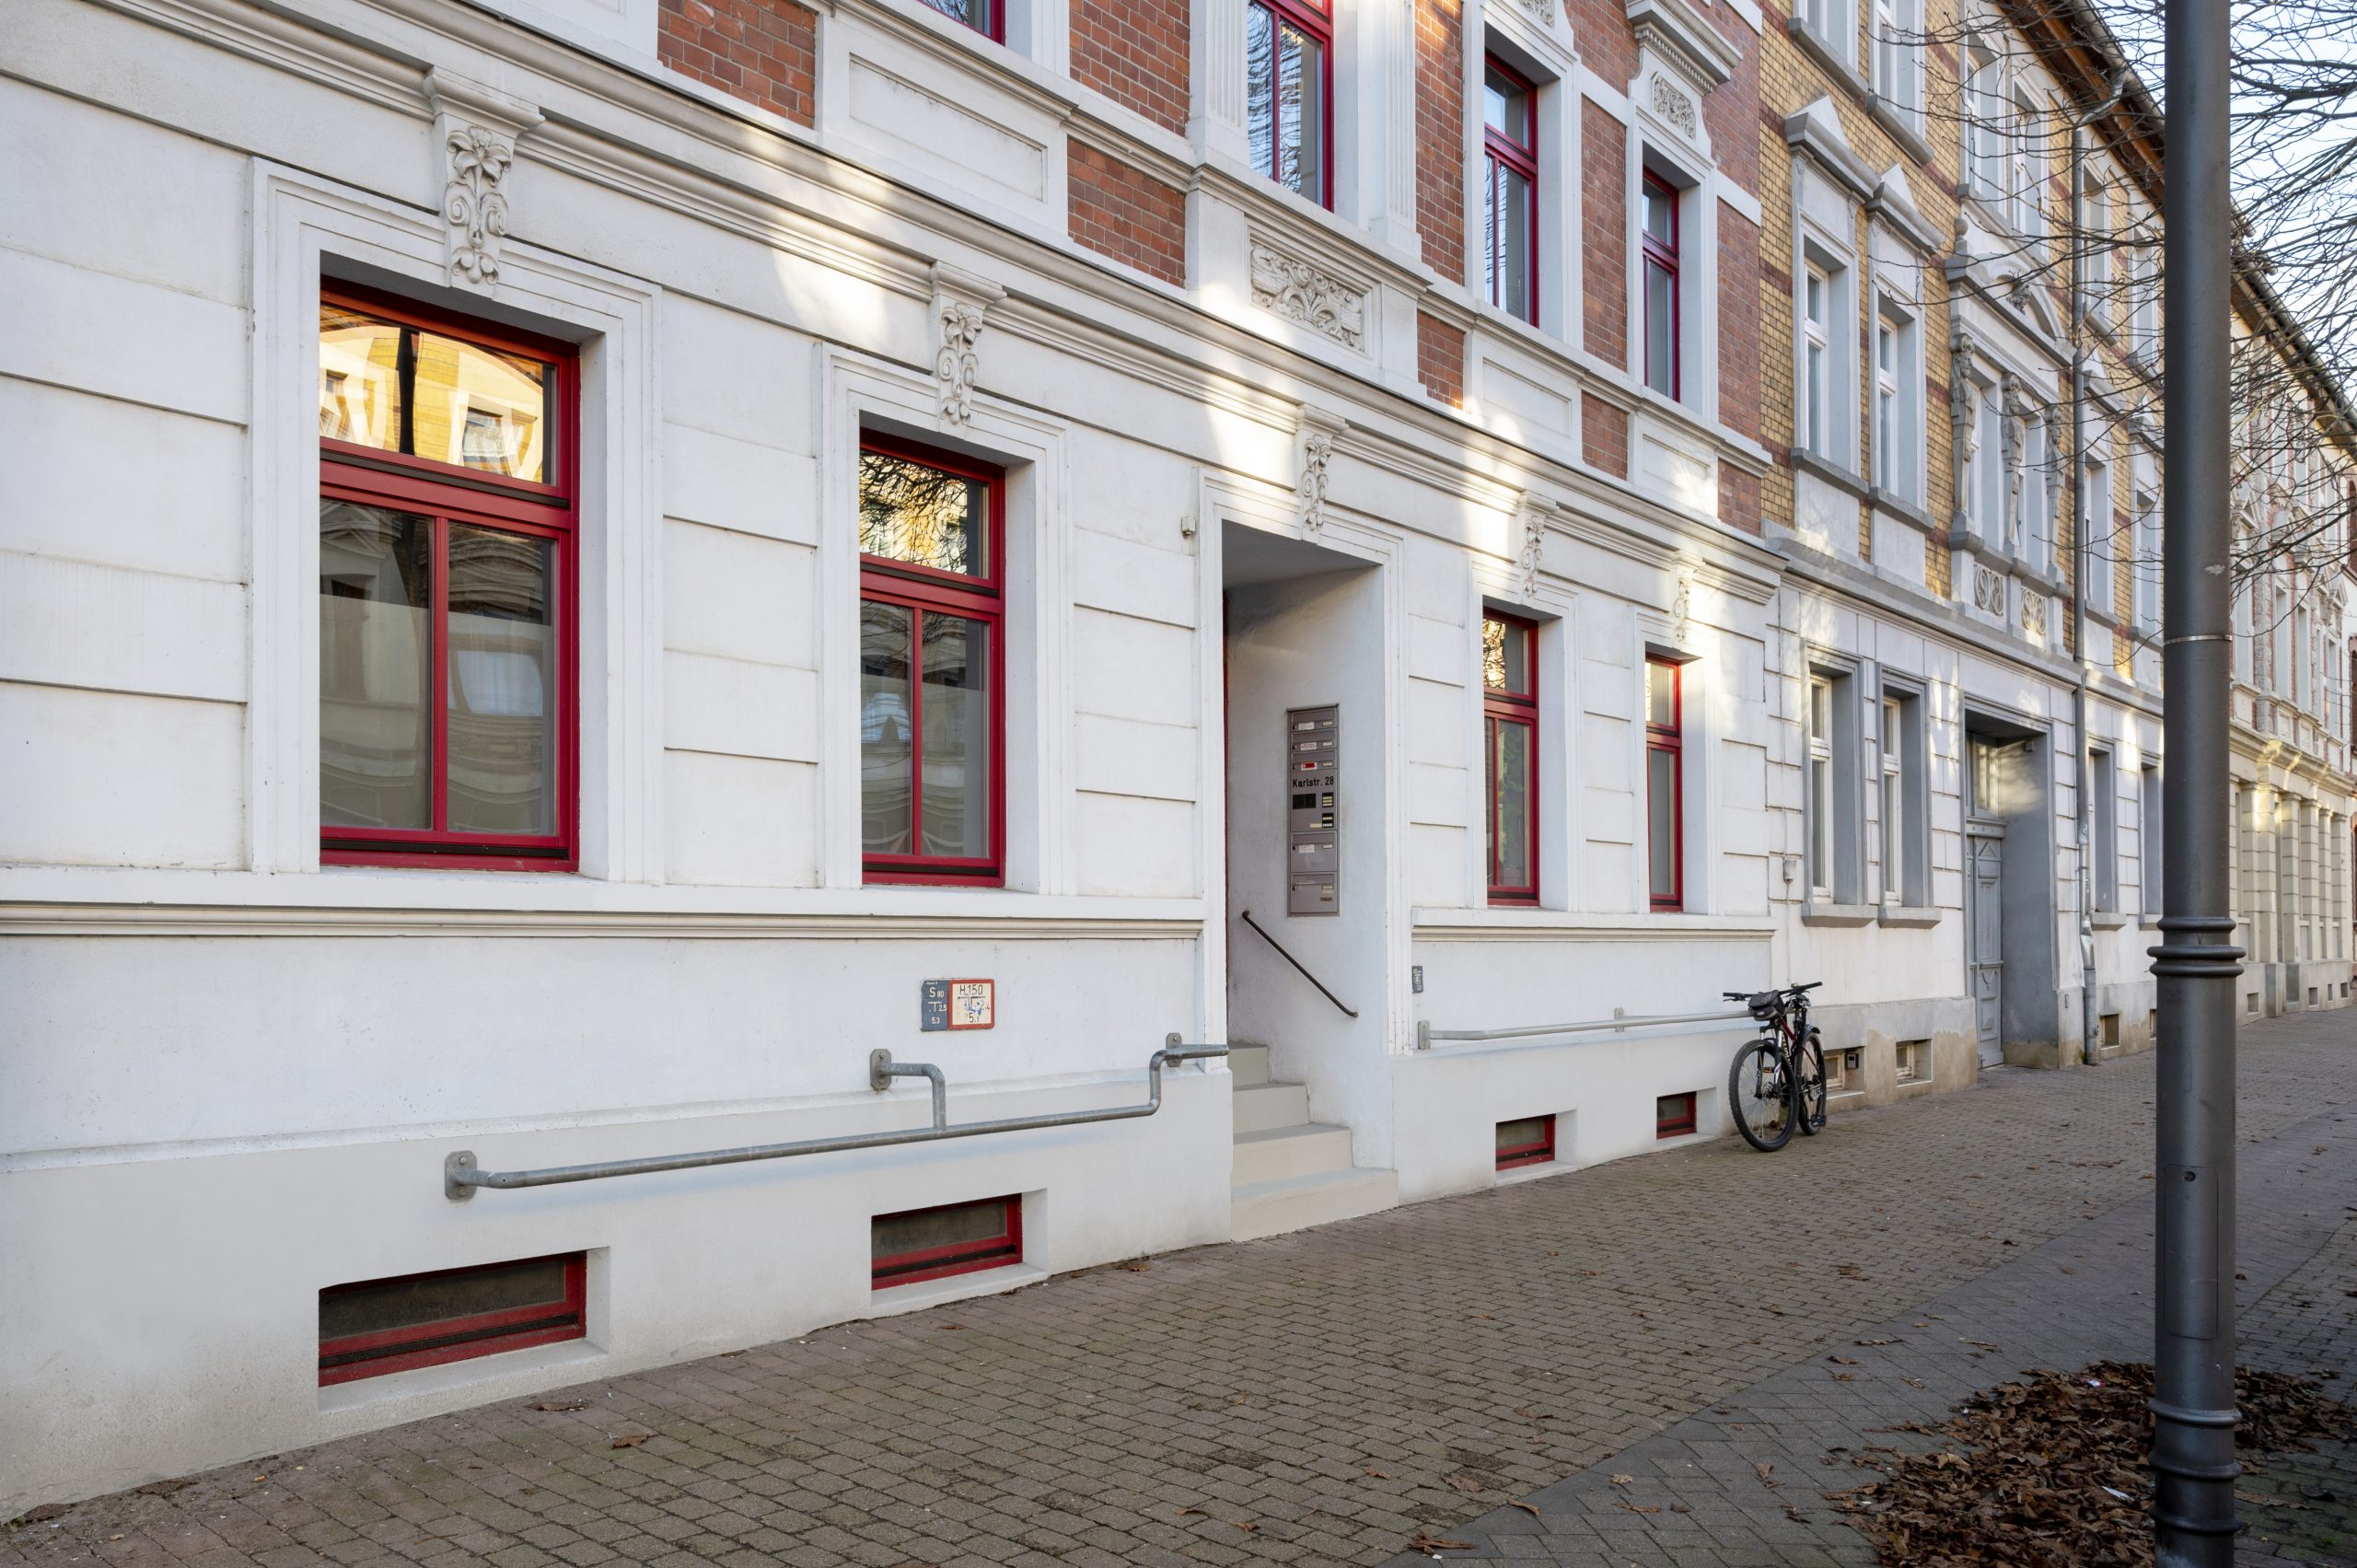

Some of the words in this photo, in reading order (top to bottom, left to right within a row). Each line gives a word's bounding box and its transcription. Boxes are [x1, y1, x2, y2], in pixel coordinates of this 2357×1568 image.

[1293, 778, 1323, 788] Karlstr.
[1325, 776, 1334, 785] 28
[929, 987, 935, 997] S
